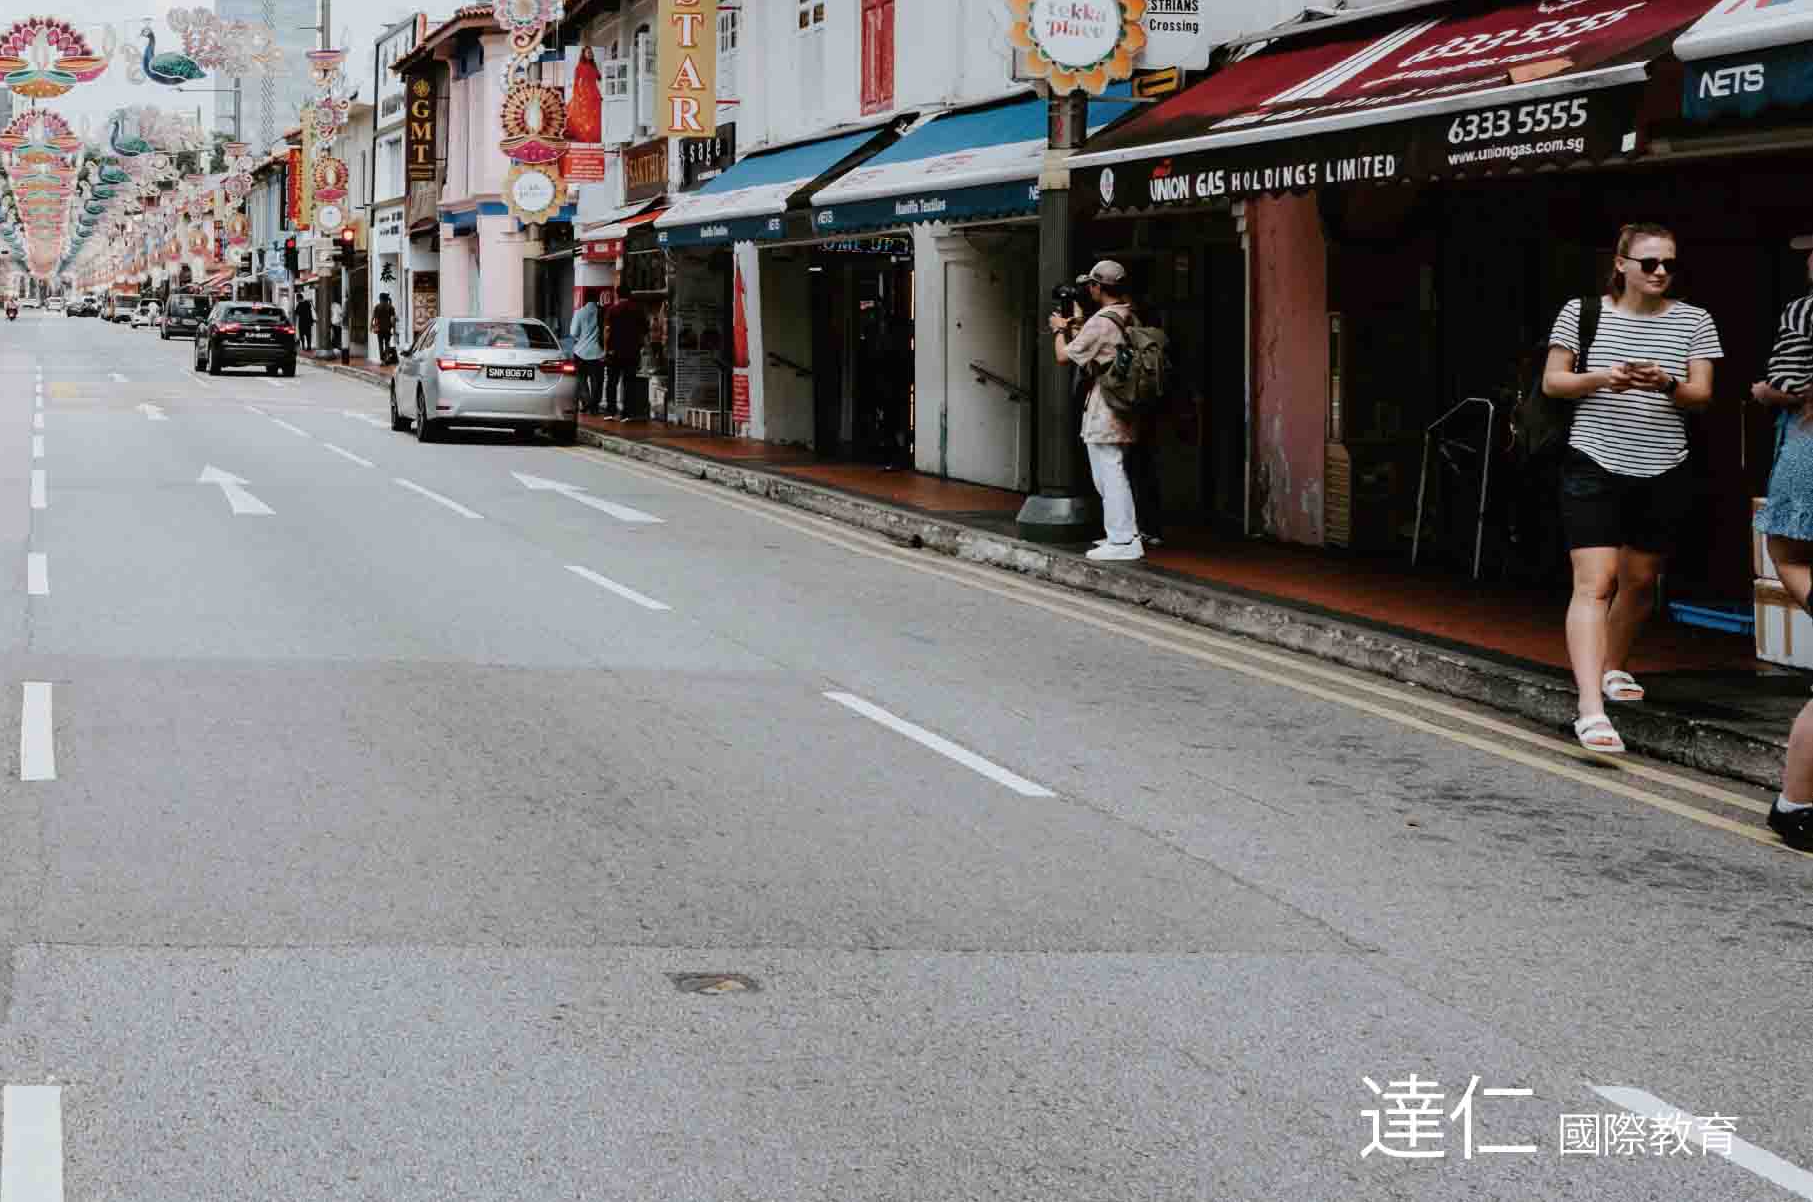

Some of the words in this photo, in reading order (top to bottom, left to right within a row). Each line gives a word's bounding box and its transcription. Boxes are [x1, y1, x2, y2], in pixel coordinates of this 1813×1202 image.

[1146, 0, 1198, 13] STRIANS
[1149, 19, 1198, 35] Crossing
[1699, 63, 1764, 98] NETS
[411, 100, 432, 163] GMT
[1448, 110, 1511, 144] 6333
[1517, 97, 1588, 134] 5555
[1447, 137, 1584, 165] www.uniongas.com.sg
[1149, 173, 1189, 202] UNION
[1195, 169, 1225, 197] GAS
[1232, 163, 1317, 191] HOLDINGS
[1325, 154, 1396, 183] LIMITED
